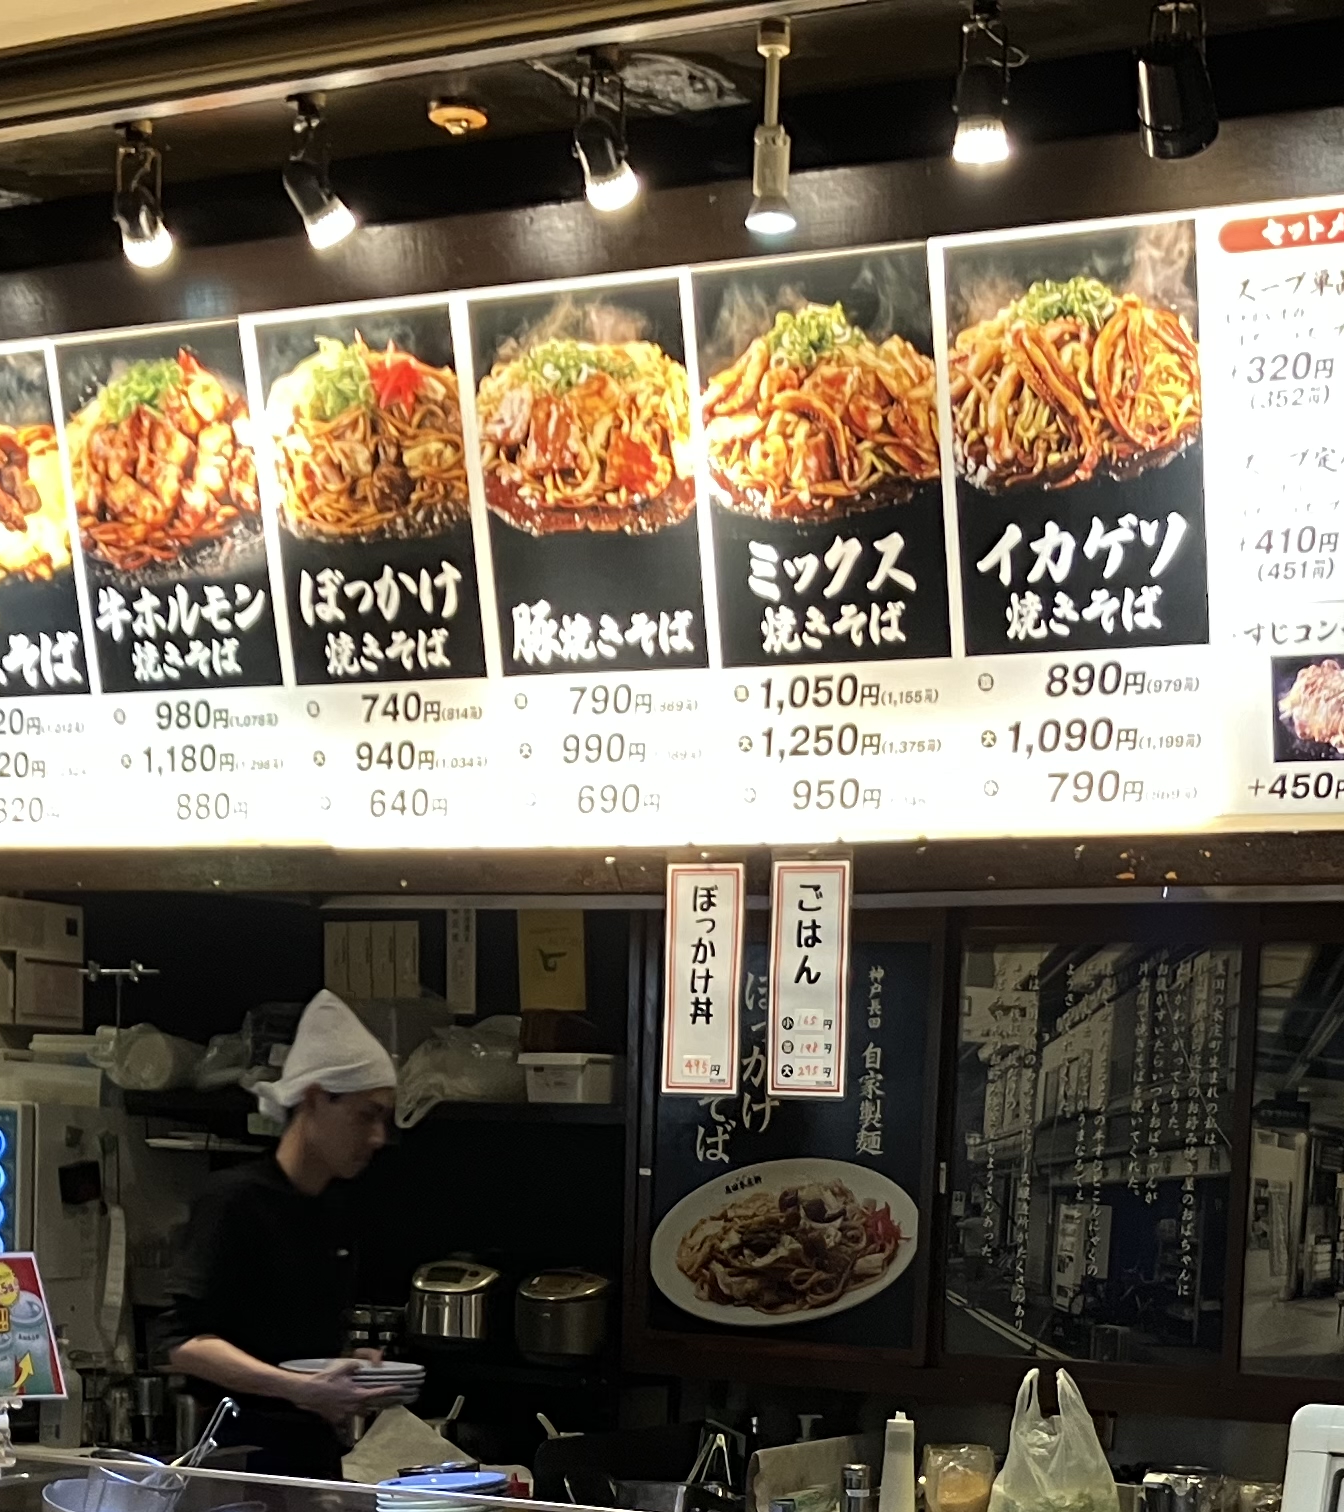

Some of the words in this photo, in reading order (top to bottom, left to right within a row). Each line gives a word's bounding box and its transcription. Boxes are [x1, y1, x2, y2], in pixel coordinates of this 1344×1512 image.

[748, 531, 918, 601] ミックス
[976, 510, 1189, 587] イカゲソ
[96, 582, 266, 642] 牛ホルモン
[299, 560, 463, 628] ぼっかけ
[761, 600, 907, 655] 焼きそば
[1006, 584, 1164, 642] 焼きそば
[132, 637, 244, 683] 焼きそば
[325, 628, 451, 677] 焼きそば
[511, 599, 695, 666] 豚焼きそば
[688, 884, 717, 1027] ぼっかけ丼
[792, 883, 825, 987] ごはん
[867, 965, 885, 1031] 神戸長田
[855, 1042, 887, 1159] 自家製麺
